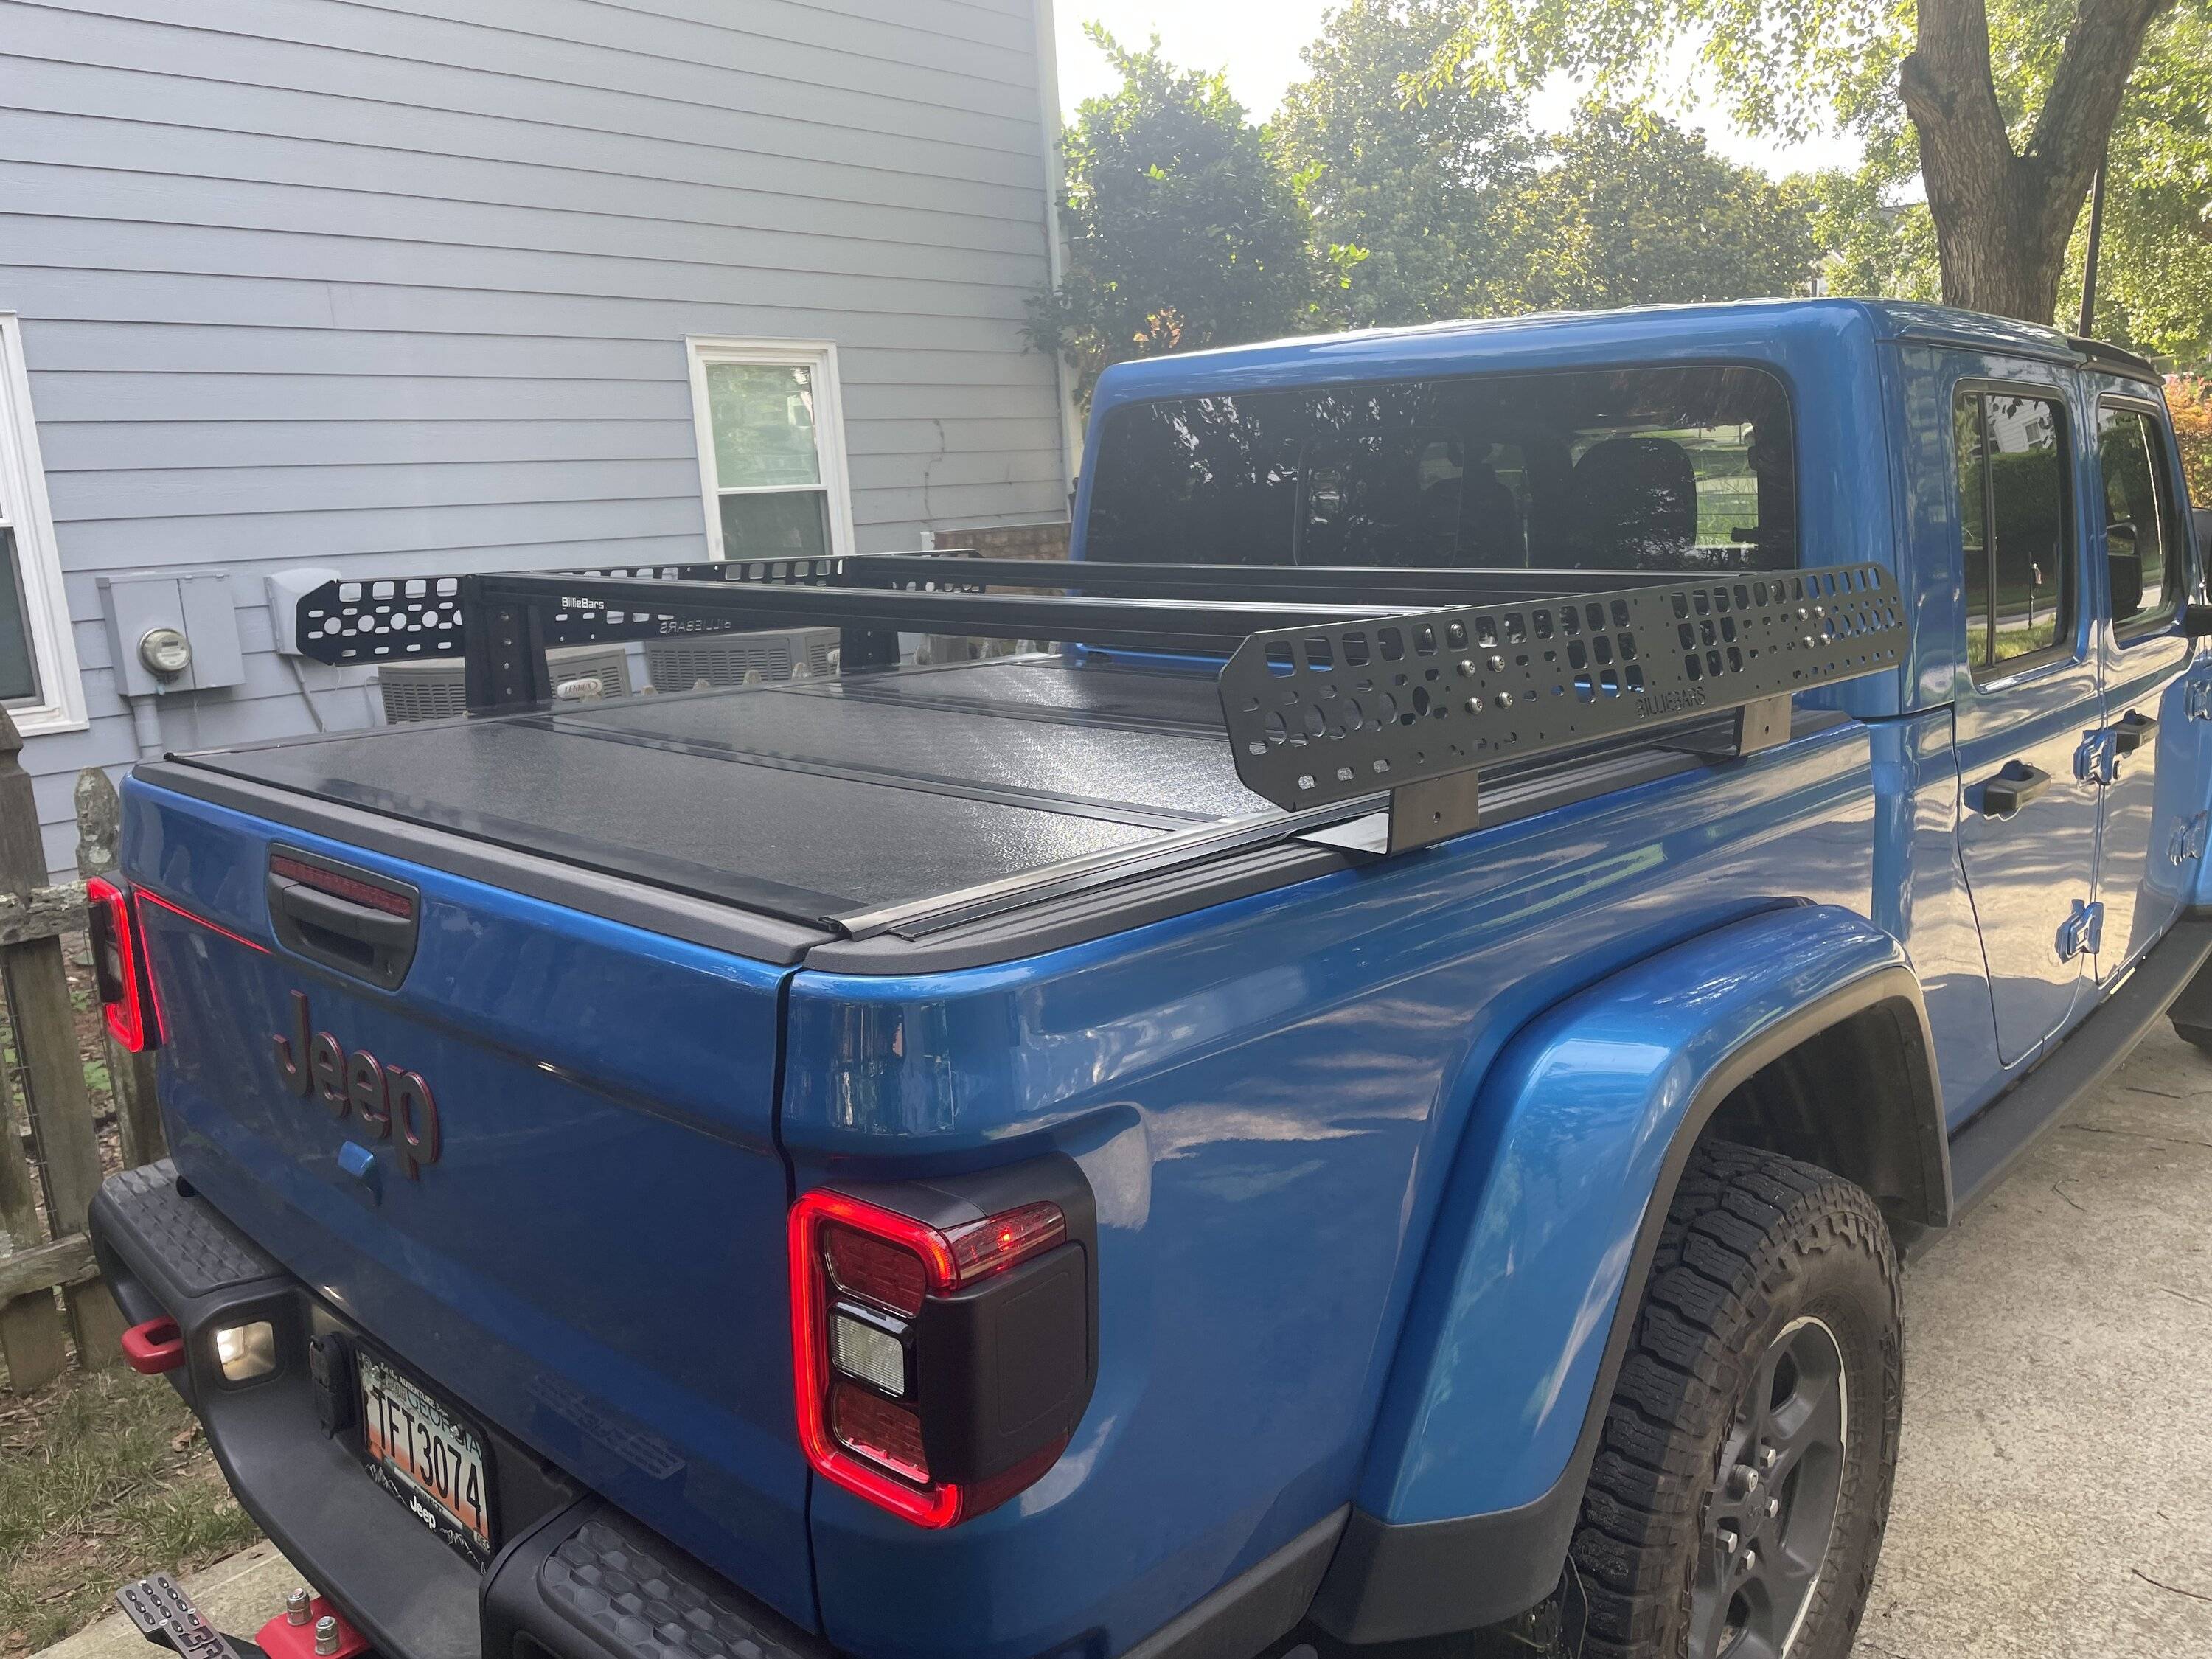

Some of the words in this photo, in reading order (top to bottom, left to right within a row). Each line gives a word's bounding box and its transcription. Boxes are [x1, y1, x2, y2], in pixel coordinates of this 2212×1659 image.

[561, 596, 605, 610] BillieBars
[272, 990, 441, 1181] Jeep
[399, 1376, 437, 1408] ADVENTURE
[372, 1385, 481, 1529] TFT3074
[409, 1495, 437, 1531] Jeep
